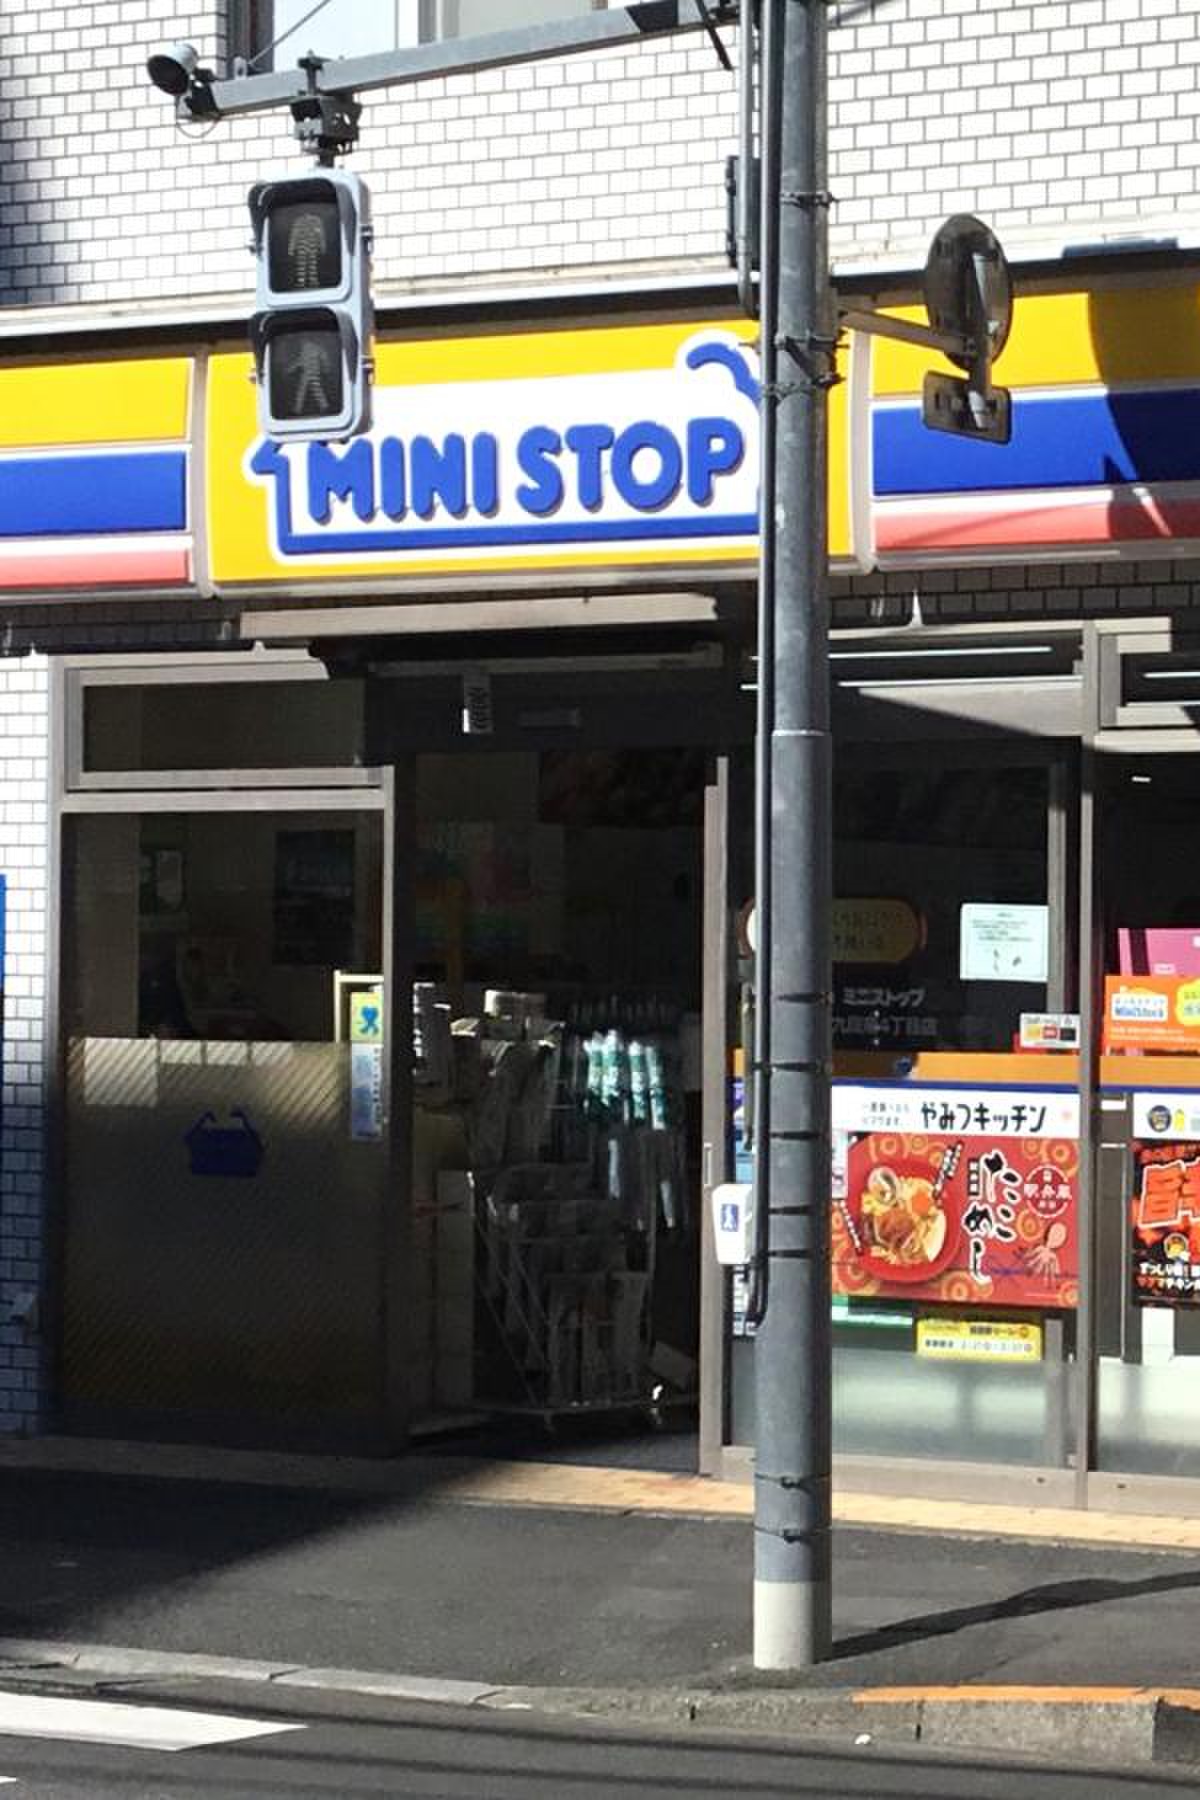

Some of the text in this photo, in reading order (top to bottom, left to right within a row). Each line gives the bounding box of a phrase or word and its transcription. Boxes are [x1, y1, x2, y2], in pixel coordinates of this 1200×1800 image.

[307, 416, 745, 523] MINI STOP
[920, 1101, 1047, 1133] やみつキッチン
